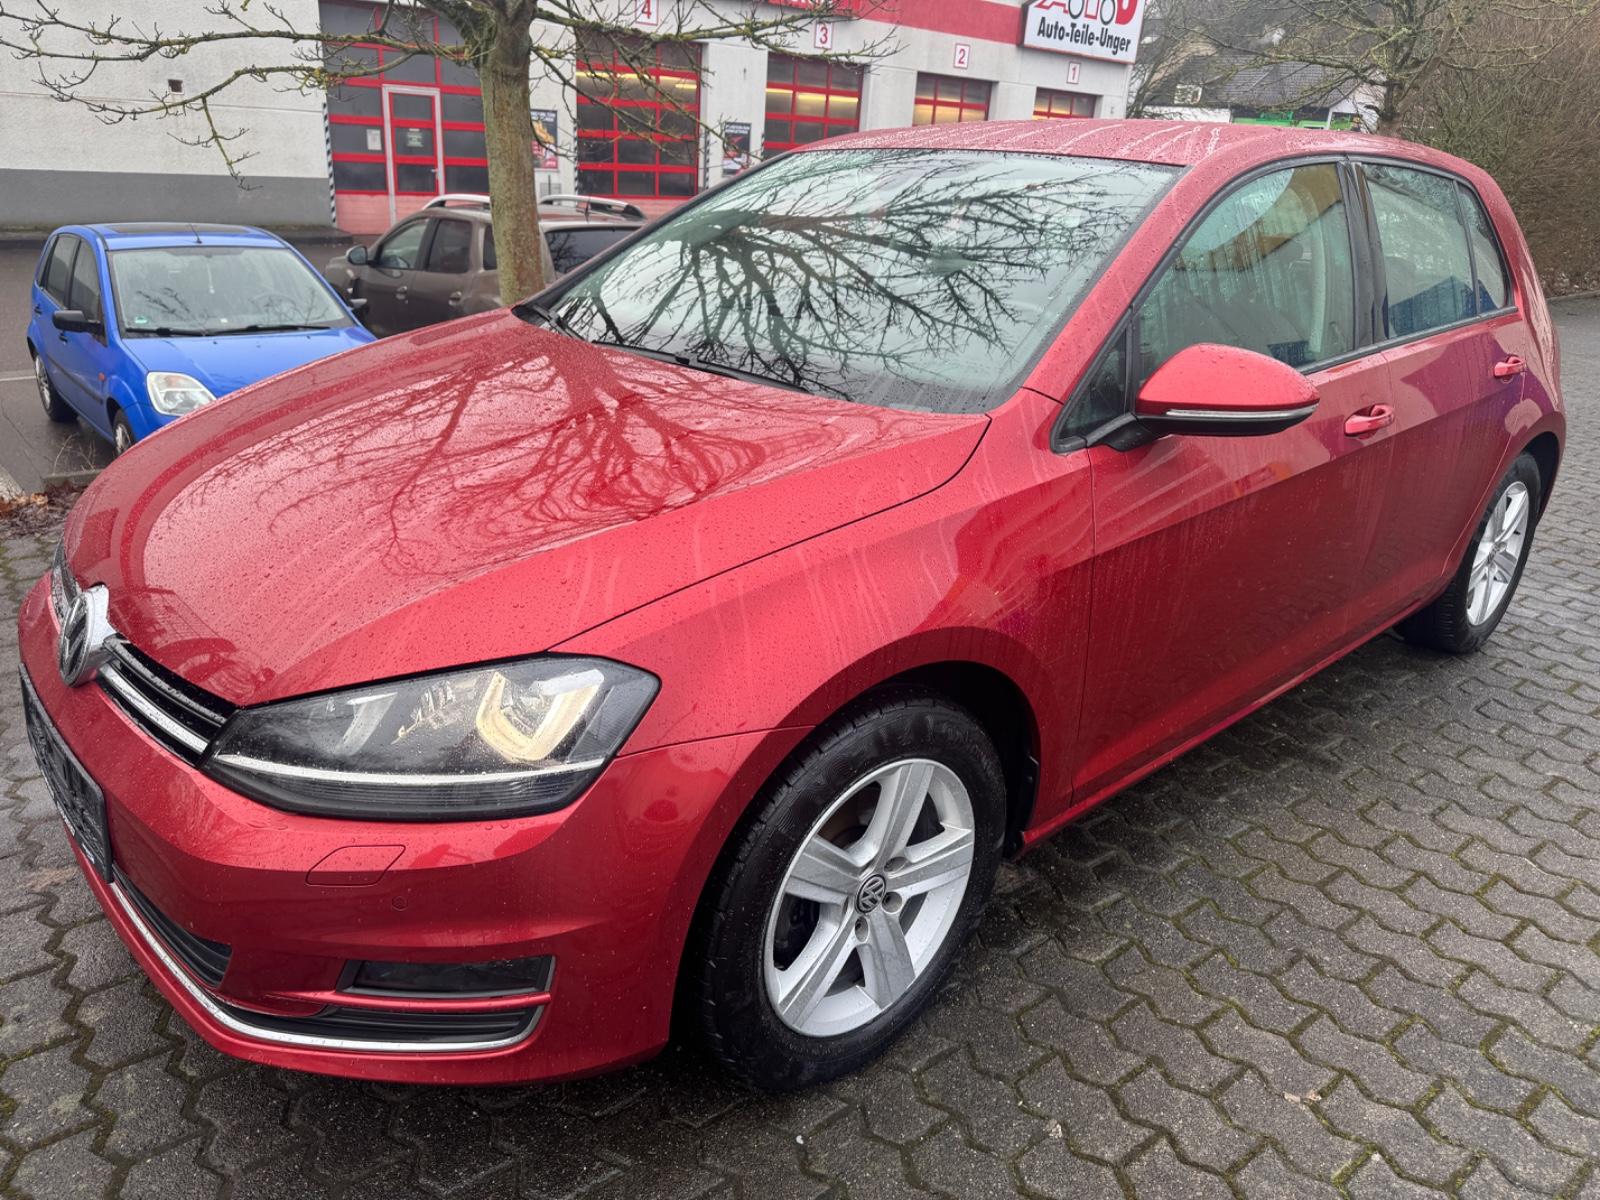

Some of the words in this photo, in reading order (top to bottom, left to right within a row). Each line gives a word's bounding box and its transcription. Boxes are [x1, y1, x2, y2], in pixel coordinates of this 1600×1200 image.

[819, 24, 829, 44] 3
[1036, 16, 1131, 55] Auto-Teile-Unger
[958, 48, 966, 65] 2
[1071, 65, 1077, 81] 1
